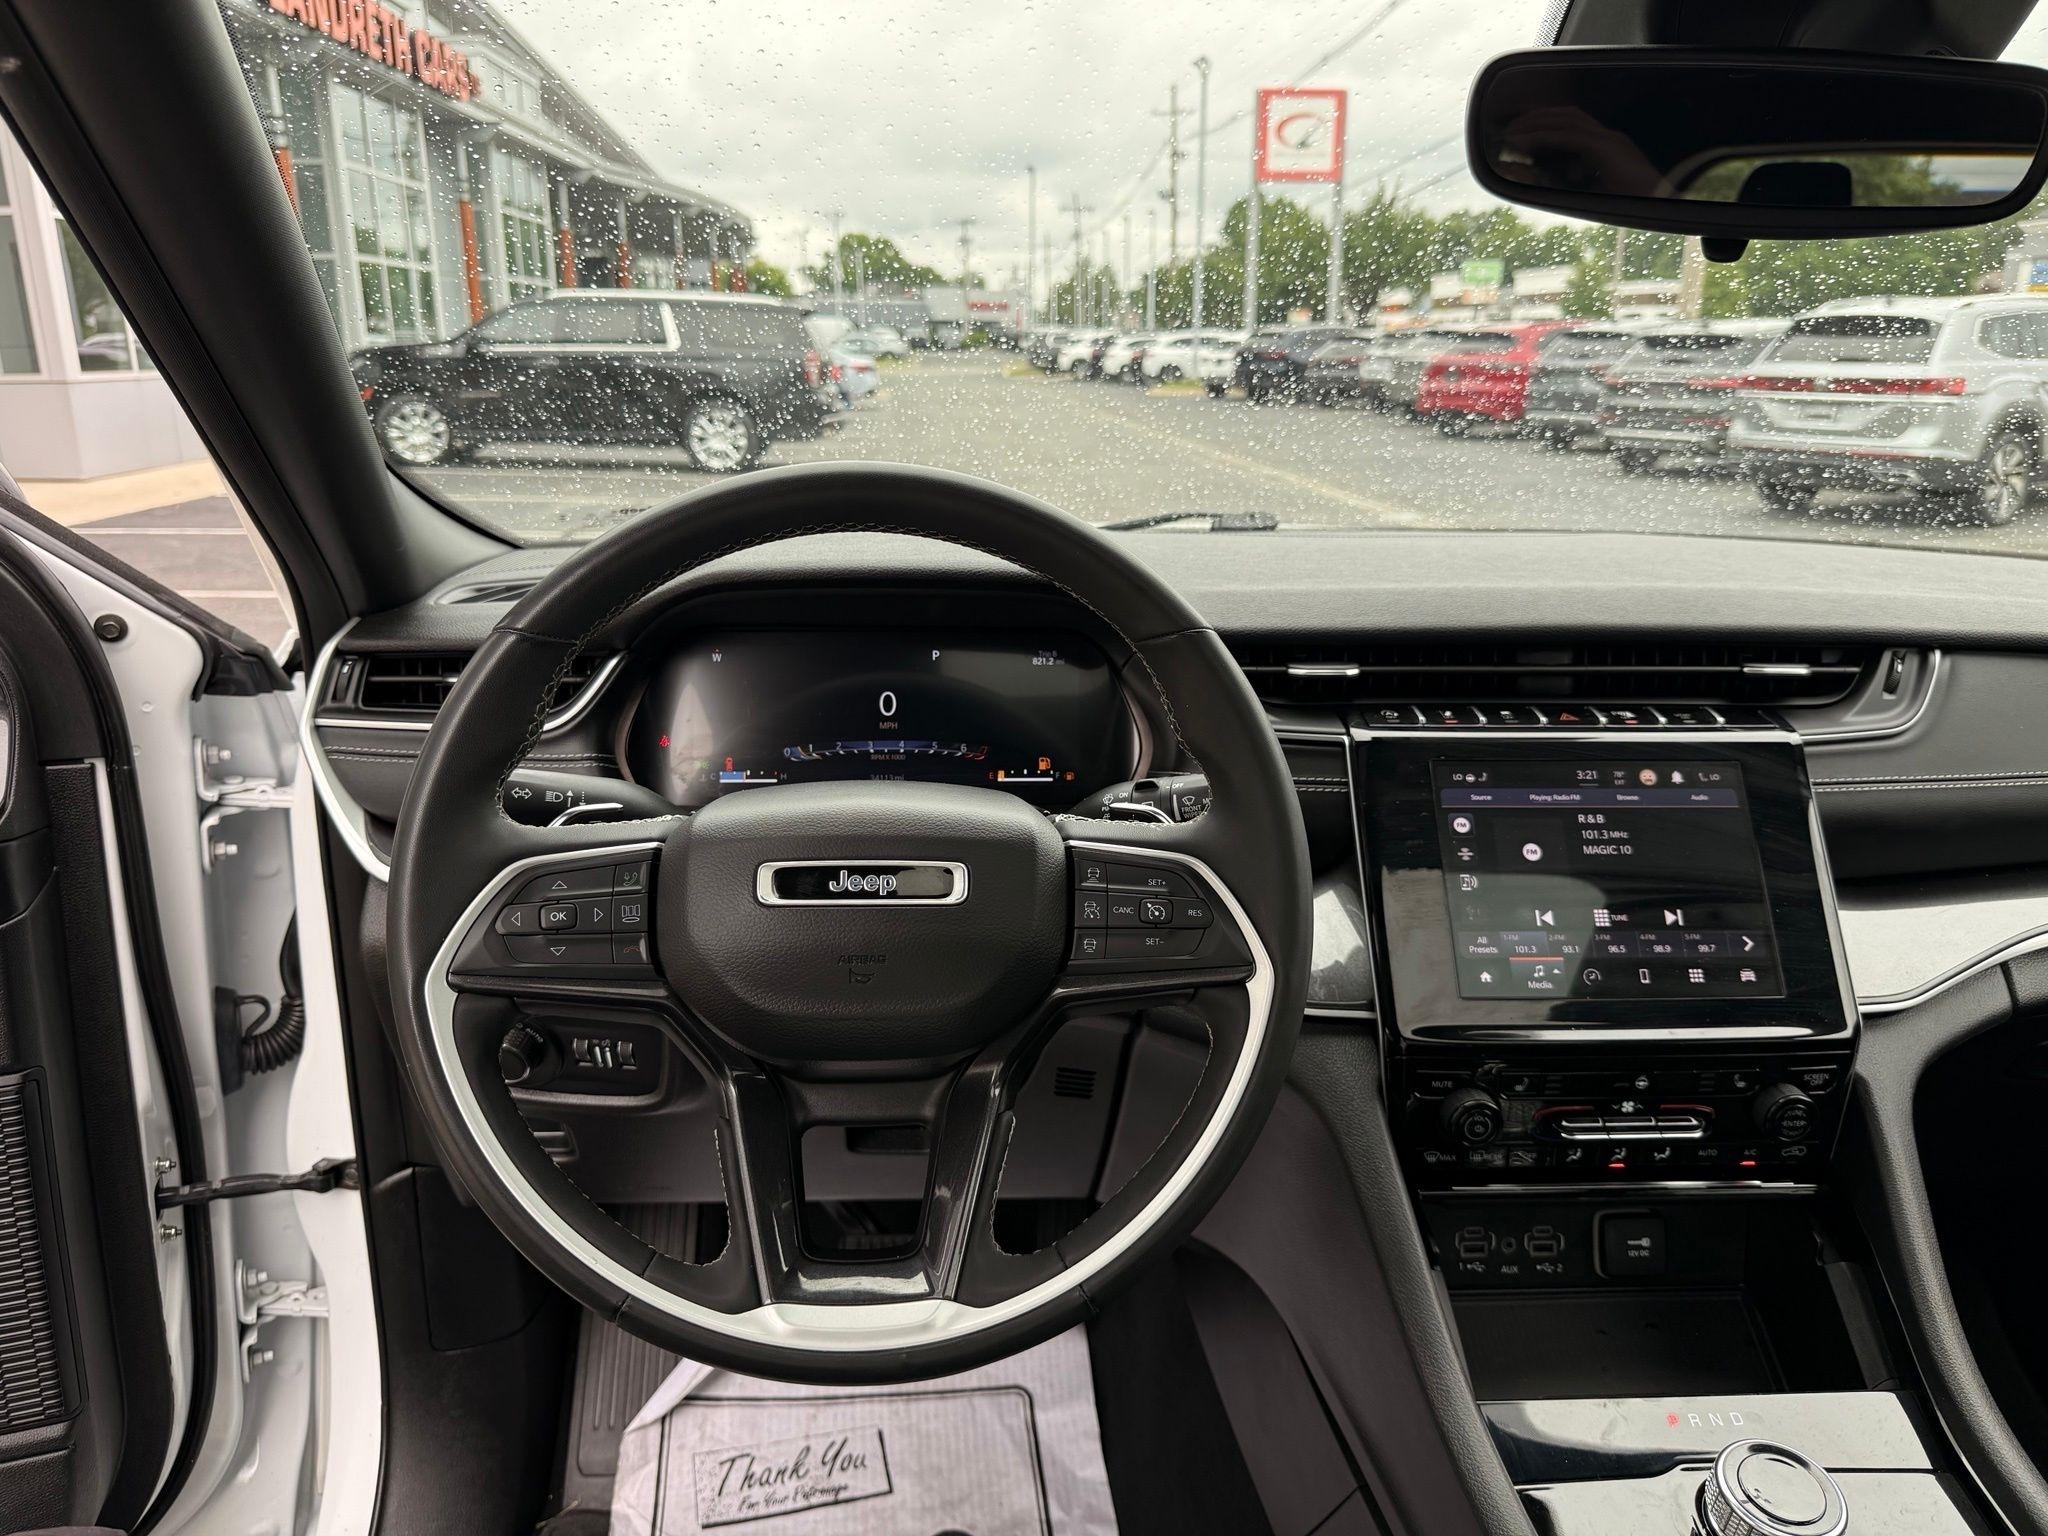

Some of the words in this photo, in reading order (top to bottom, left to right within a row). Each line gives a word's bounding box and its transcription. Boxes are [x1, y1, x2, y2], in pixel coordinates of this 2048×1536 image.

[712, 653, 722, 662] W
[931, 650, 940, 660] P
[1032, 657, 1054, 665] 821.2
[879, 690, 897, 716] 0
[879, 721, 898, 730] MPH
[808, 743, 813, 752] 1
[836, 741, 842, 750] 2
[868, 741, 874, 749] 3
[899, 740, 905, 749] 4
[931, 741, 938, 750] 5
[960, 743, 967, 753] 6
[784, 747, 790, 757] 0
[780, 773, 787, 781] H
[1453, 773, 1463, 781] LO
[1577, 770, 1597, 779] 3:21
[1710, 773, 1720, 781] LO
[1181, 804, 1201, 812] FRONT
[1578, 814, 1585, 823] R
[1587, 814, 1596, 823] &
[1597, 814, 1605, 823] B
[1582, 830, 1608, 839] 101.3
[1609, 831, 1629, 839] MHz
[1582, 845, 1617, 855] MAGIC
[1620, 845, 1632, 855] 10
[829, 869, 897, 896] Jeep
[1148, 879, 1166, 887] SET+
[1113, 906, 1134, 914] CANC
[1188, 909, 1203, 917] RES
[550, 911, 567, 921] OK
[1611, 914, 1628, 922] TUNE
[1469, 946, 1497, 954] Presets
[1514, 945, 1537, 953] 101.3
[1562, 945, 1579, 953] 93.1
[1607, 945, 1626, 953] 96.5
[1653, 945, 1671, 953] 98.9
[1697, 945, 1715, 953] 99.7
[1528, 981, 1551, 989] Media
[1803, 1073, 1830, 1081] SCREEN
[1431, 1080, 1453, 1088] MUTE
[1500, 1265, 1518, 1273] AUX
[1557, 1263, 1563, 1272] 2
[1688, 1413, 1702, 1427] R
[1708, 1412, 1724, 1426] N
[1730, 1411, 1744, 1426] D
[717, 1445, 811, 1497] Thank
[821, 1435, 868, 1477] You
[736, 1499, 756, 1512] For
